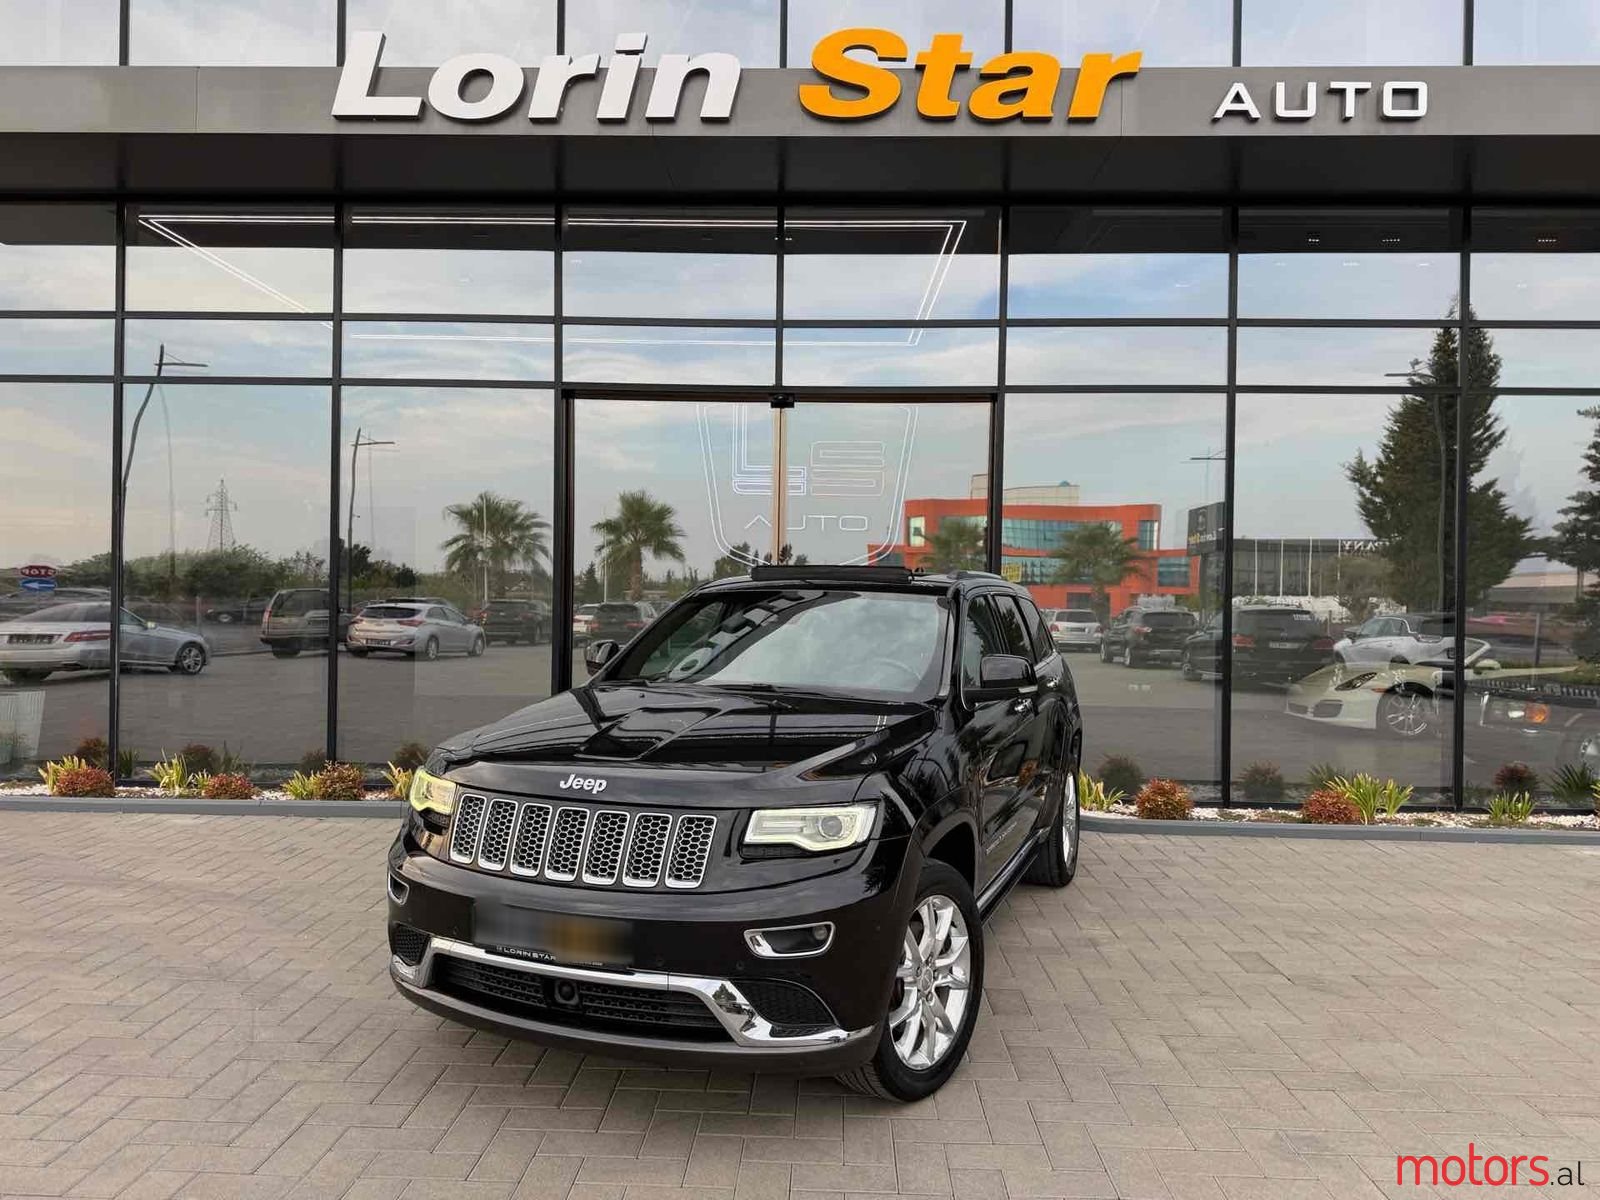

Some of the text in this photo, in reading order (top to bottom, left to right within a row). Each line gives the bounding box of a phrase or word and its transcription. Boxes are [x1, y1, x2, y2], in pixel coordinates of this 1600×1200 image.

[331, 27, 1429, 124] Lorin Star AUTO
[559, 773, 607, 794] Jeep
